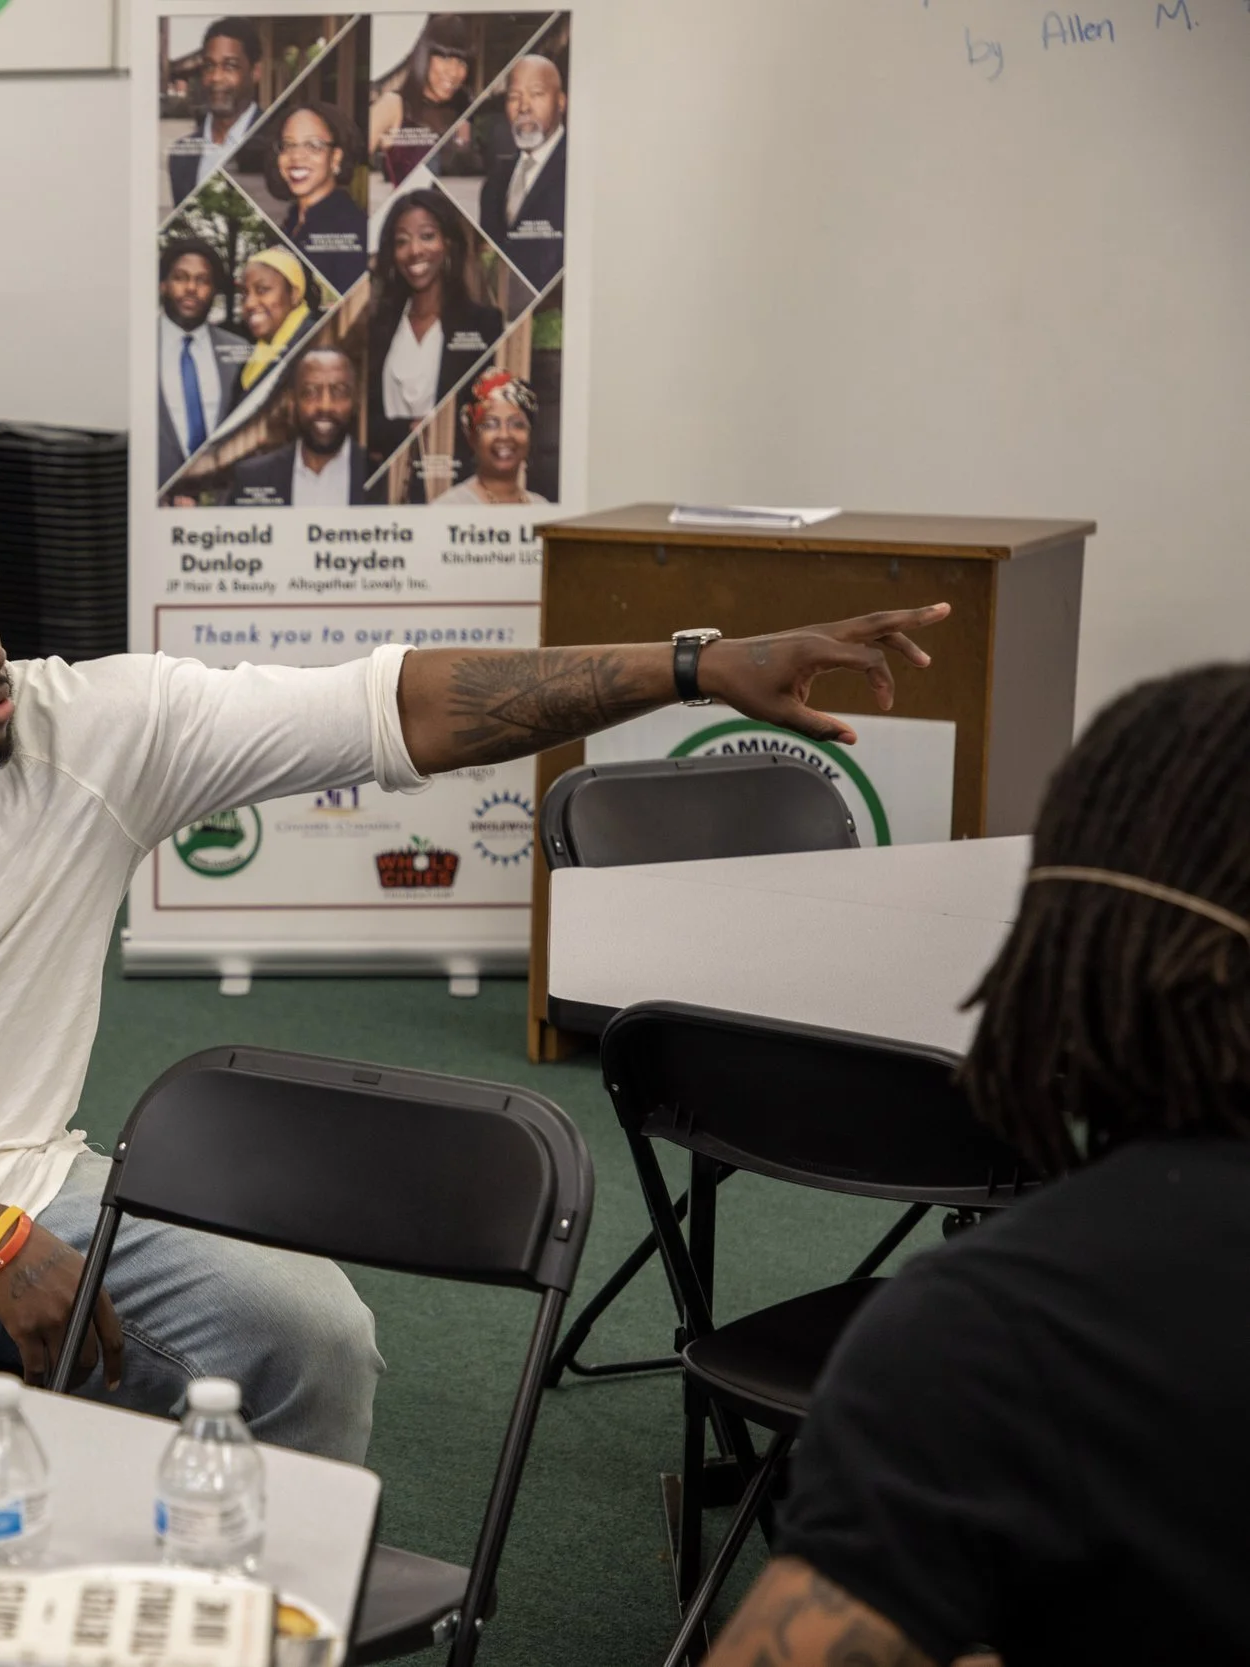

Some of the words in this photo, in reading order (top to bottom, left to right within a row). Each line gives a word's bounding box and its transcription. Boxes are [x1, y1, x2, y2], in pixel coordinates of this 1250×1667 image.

[964, 24, 1004, 81] by
[1042, 11, 1115, 50] Allen
[1155, 0, 1200, 30] M.
[171, 525, 273, 550] Reginald
[307, 522, 414, 543] Demetria
[448, 523, 510, 543] Trista
[181, 552, 263, 576] Dunlop
[314, 549, 406, 575] Hayden
[233, 578, 277, 595] Beauty
[361, 576, 402, 594] Lovely
[192, 624, 261, 646] Thank
[270, 628, 312, 651] you
[321, 626, 346, 645] to
[355, 628, 394, 644] our
[404, 626, 515, 649] sponsors:
[376, 854, 456, 871] WHOLE
